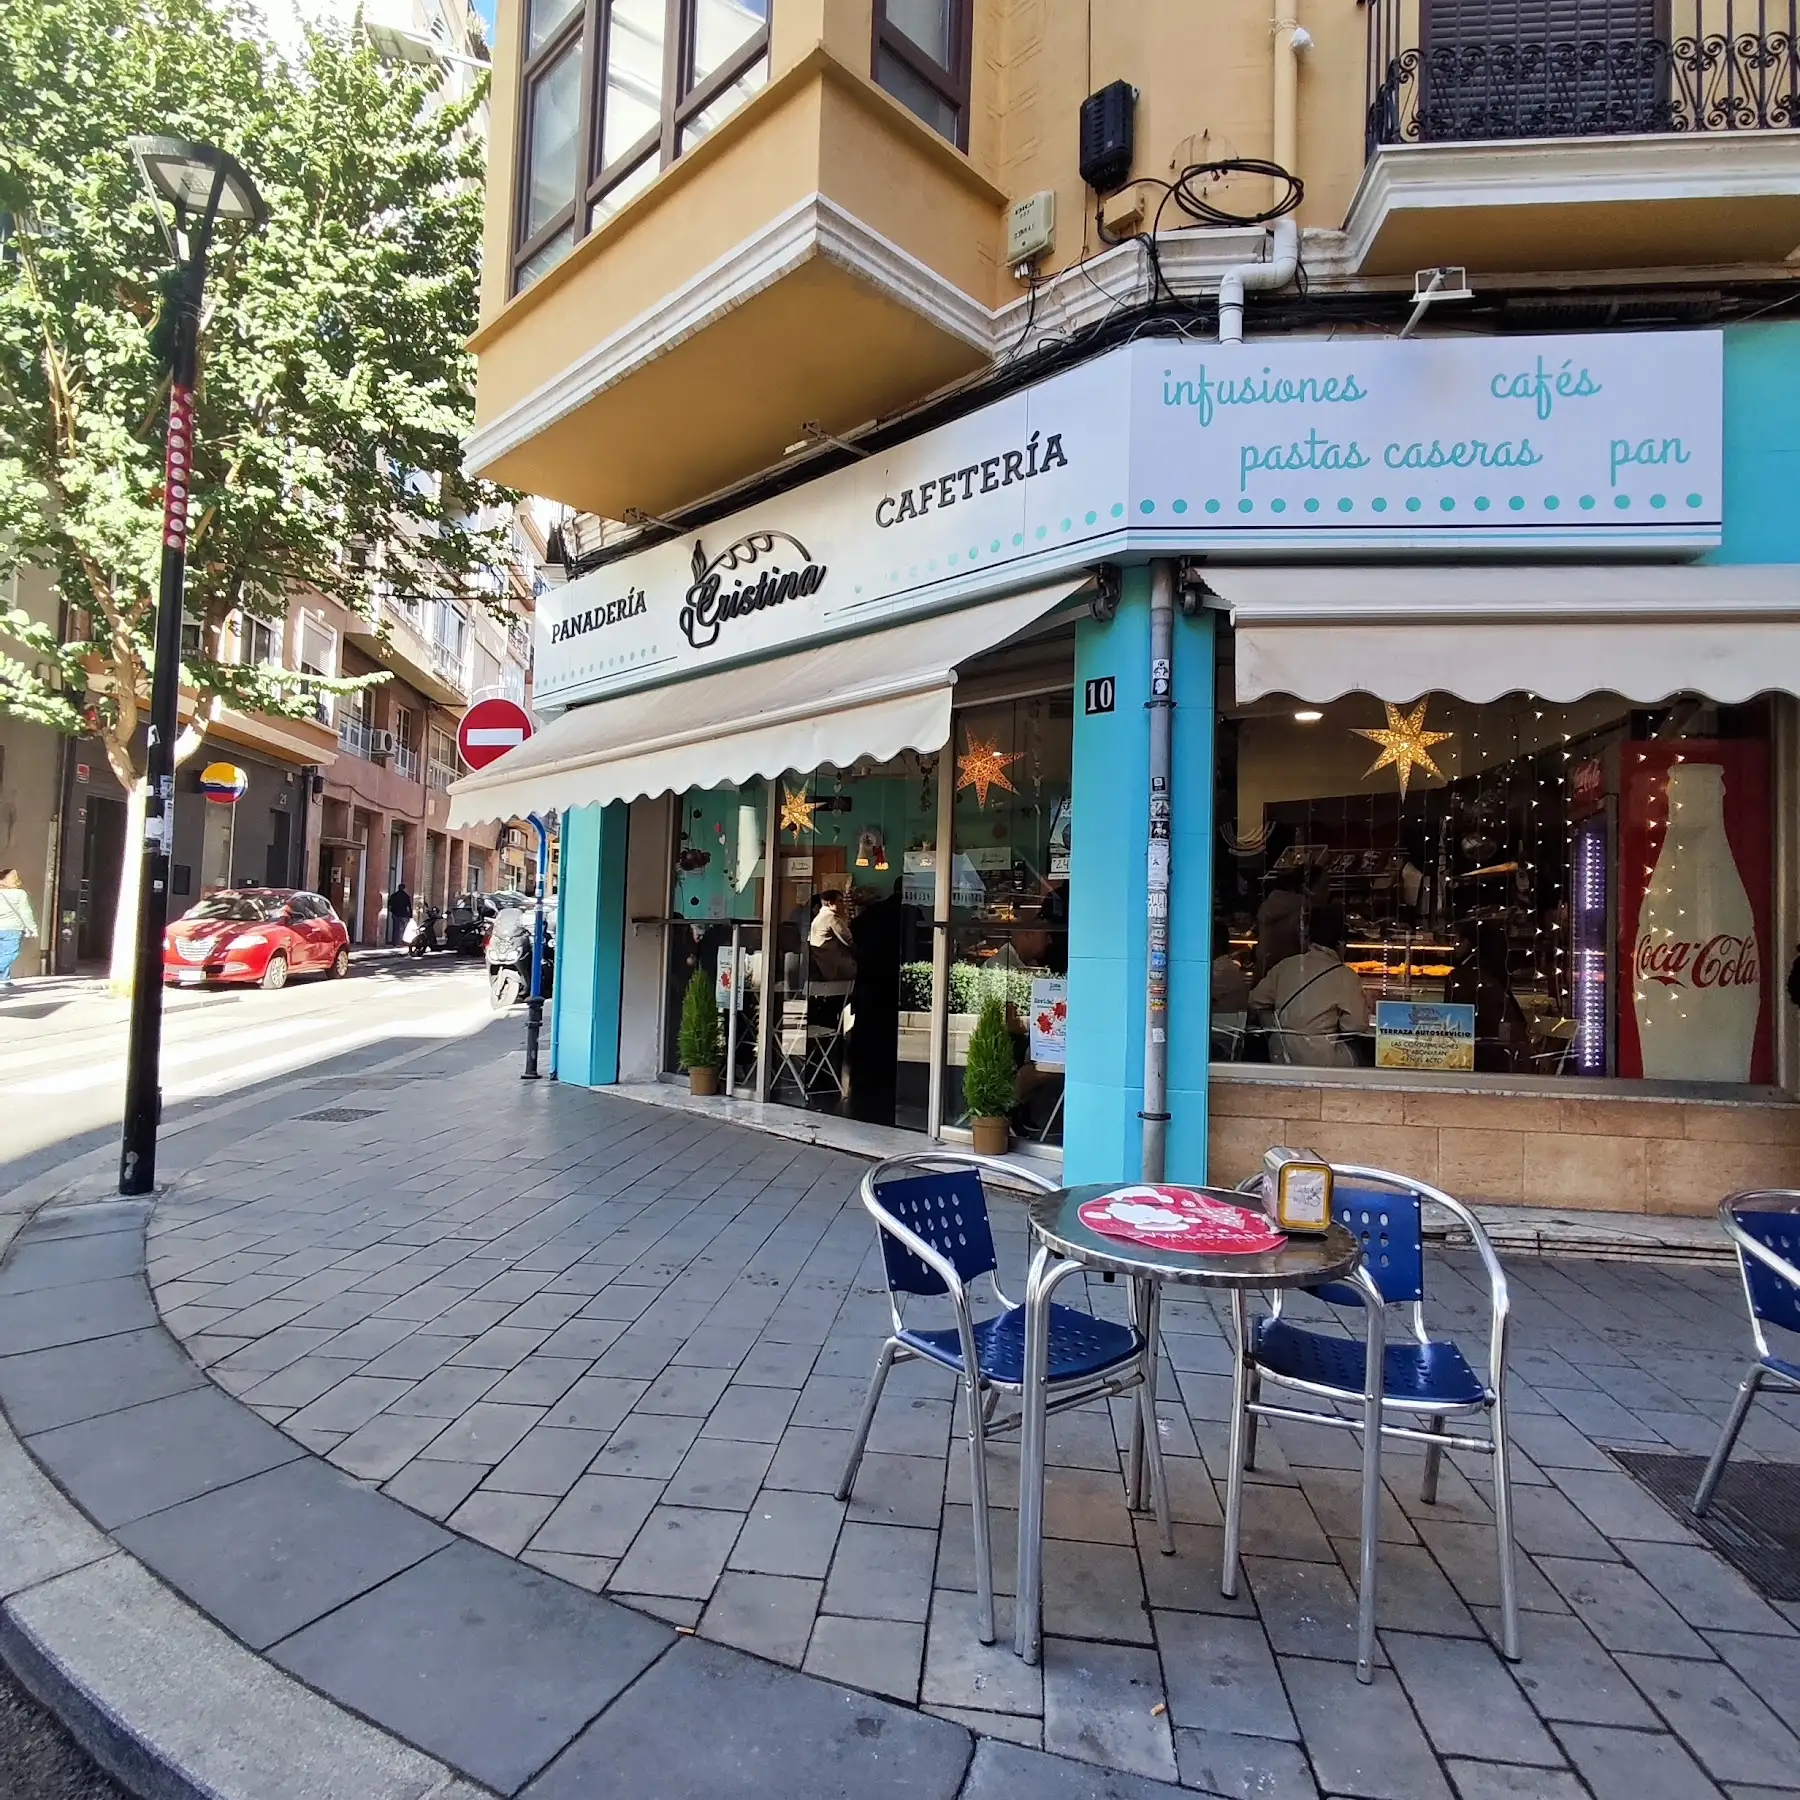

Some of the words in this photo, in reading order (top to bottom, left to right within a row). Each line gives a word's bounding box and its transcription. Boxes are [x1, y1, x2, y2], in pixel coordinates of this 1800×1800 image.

[1163, 363, 1368, 428] infusiones
[1490, 354, 1603, 421] cafés
[875, 429, 1068, 529] CAFETERÍA
[1240, 427, 1371, 492] pastas
[1383, 437, 1543, 469] caseras
[1610, 437, 1691, 487] pan
[551, 586, 648, 645] PANADERÍA
[680, 564, 827, 648] Cristina
[1087, 679, 1113, 712] 10
[1636, 934, 1757, 989] Coca-Cola
[1380, 1028, 1413, 1036] TERRAZA
